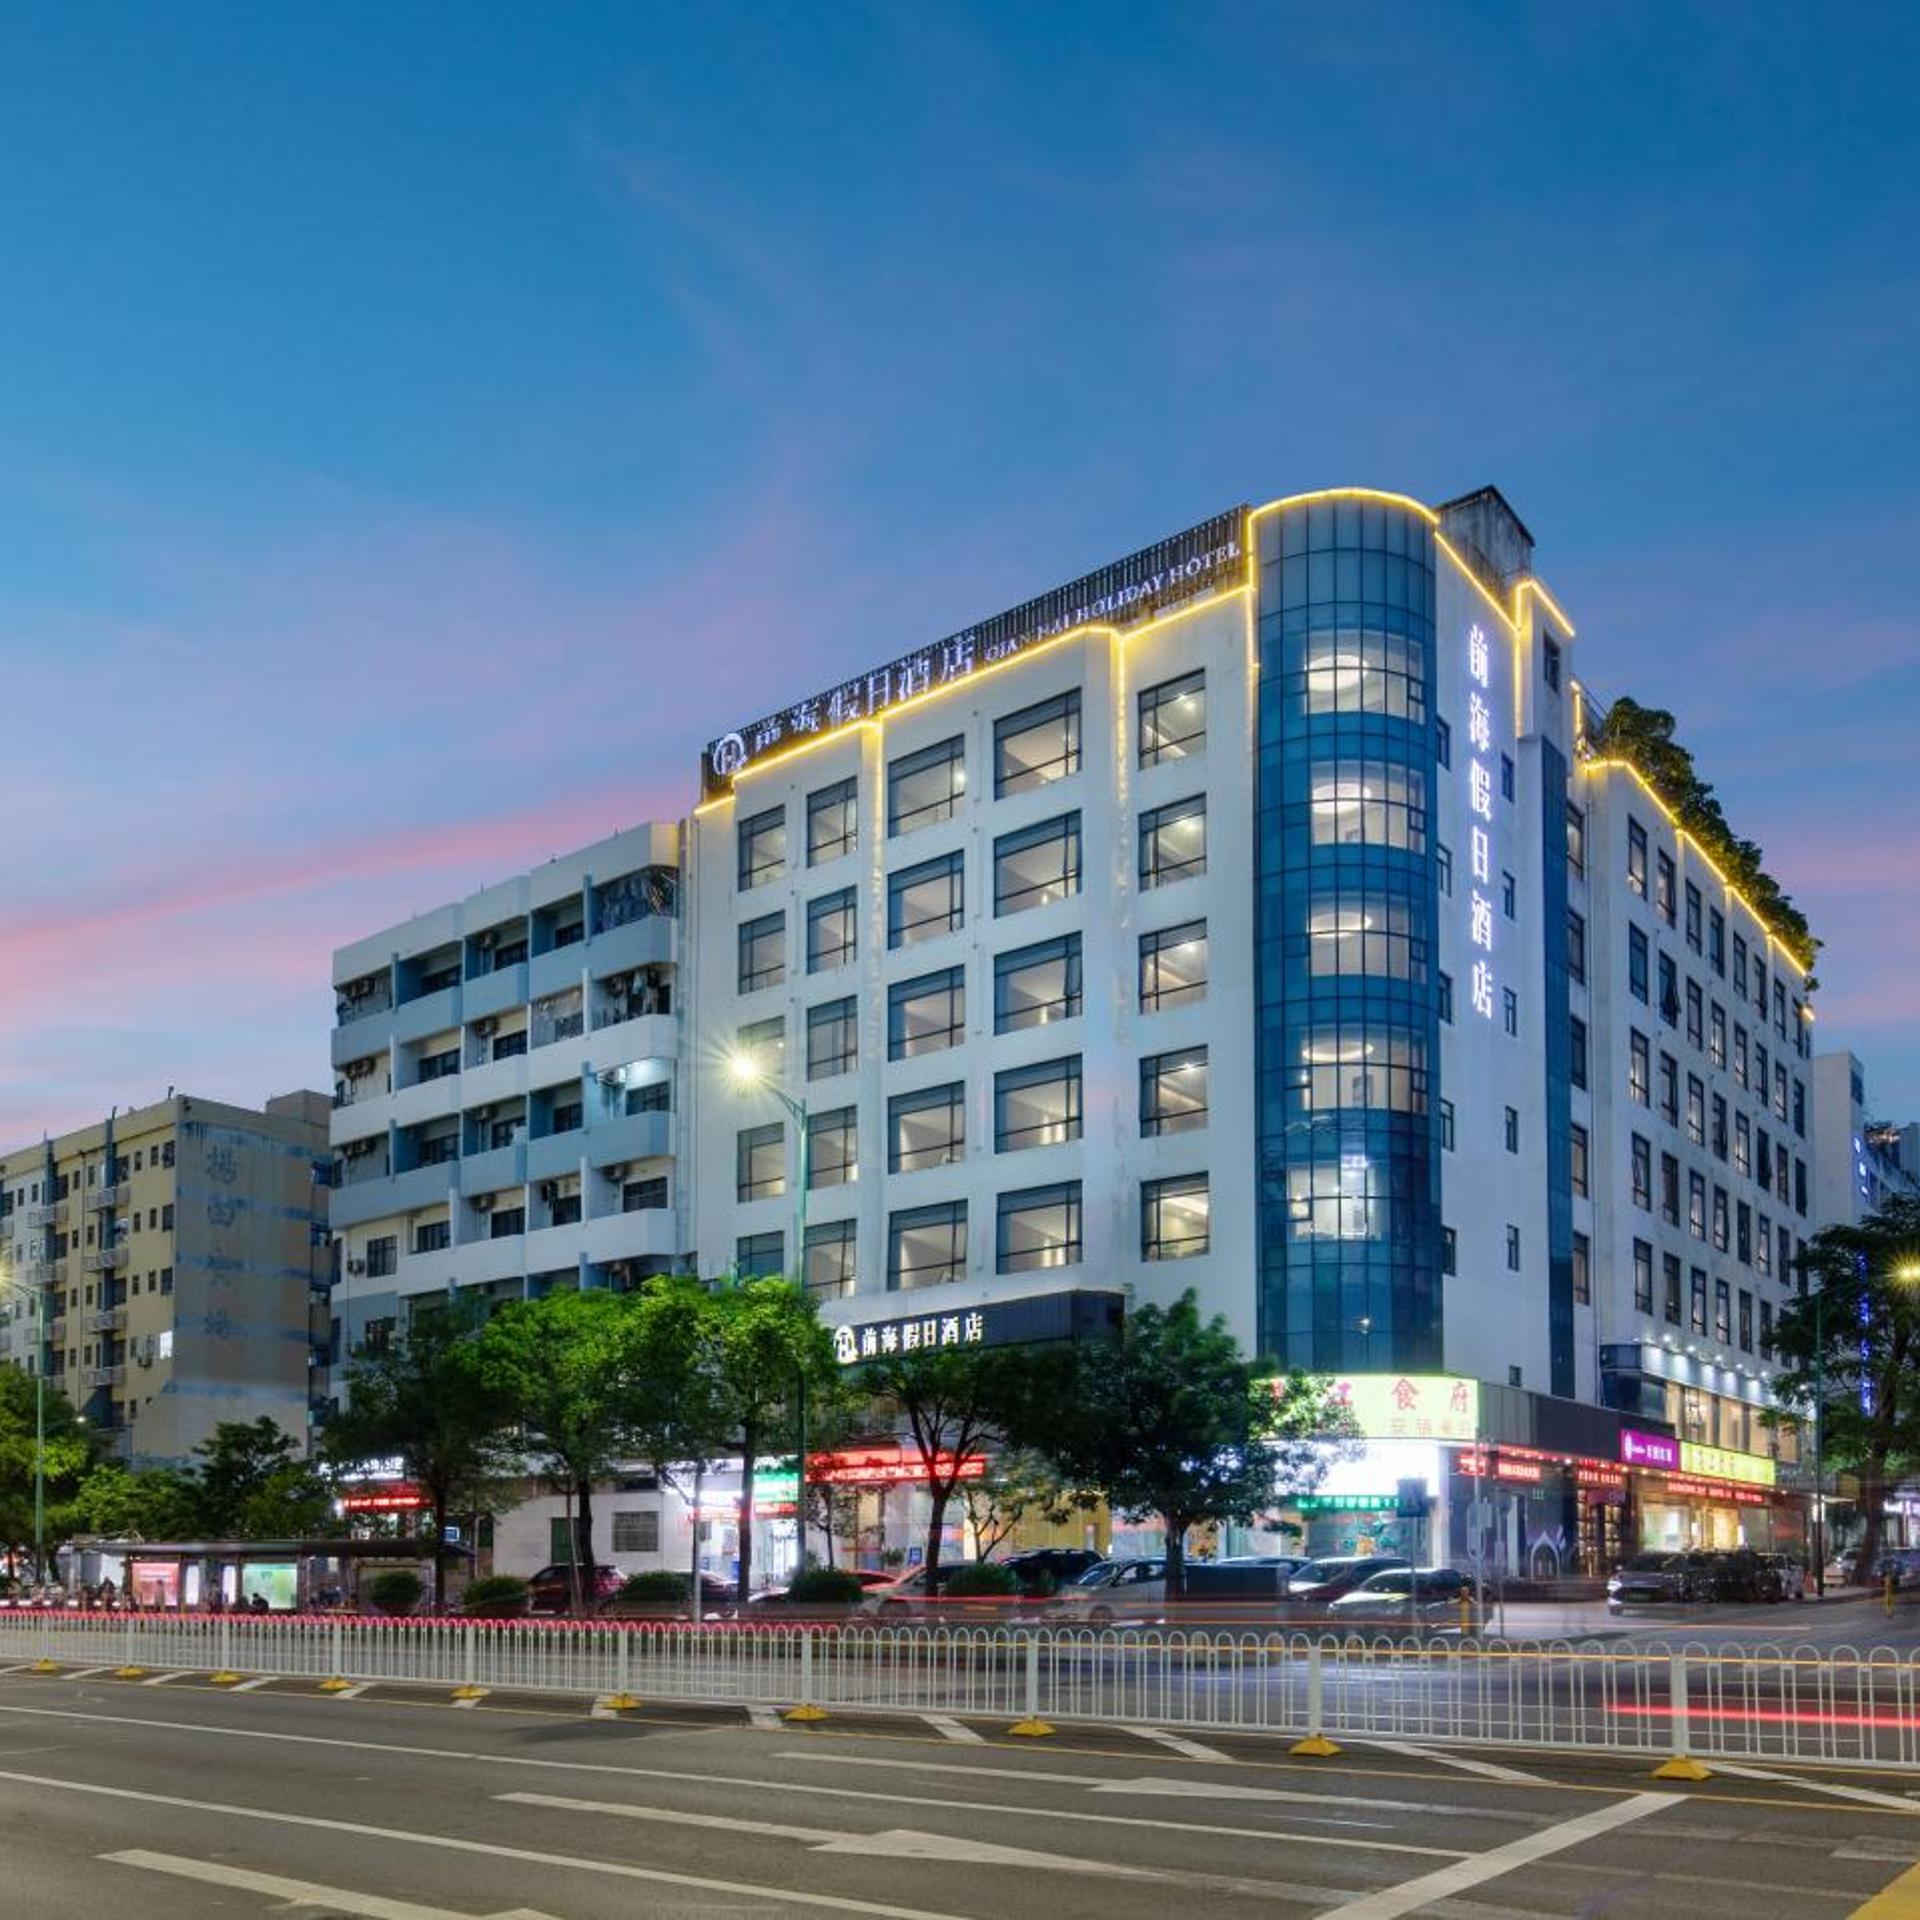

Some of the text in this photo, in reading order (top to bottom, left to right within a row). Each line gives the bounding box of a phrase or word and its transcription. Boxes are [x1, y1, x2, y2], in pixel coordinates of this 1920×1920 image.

[1077, 571, 1166, 624] HOLIDAY
[1170, 541, 1241, 586] HOTEL
[1469, 624, 1492, 1019] 前海假日酒店
[862, 1312, 983, 1356] 前海假日酒店
